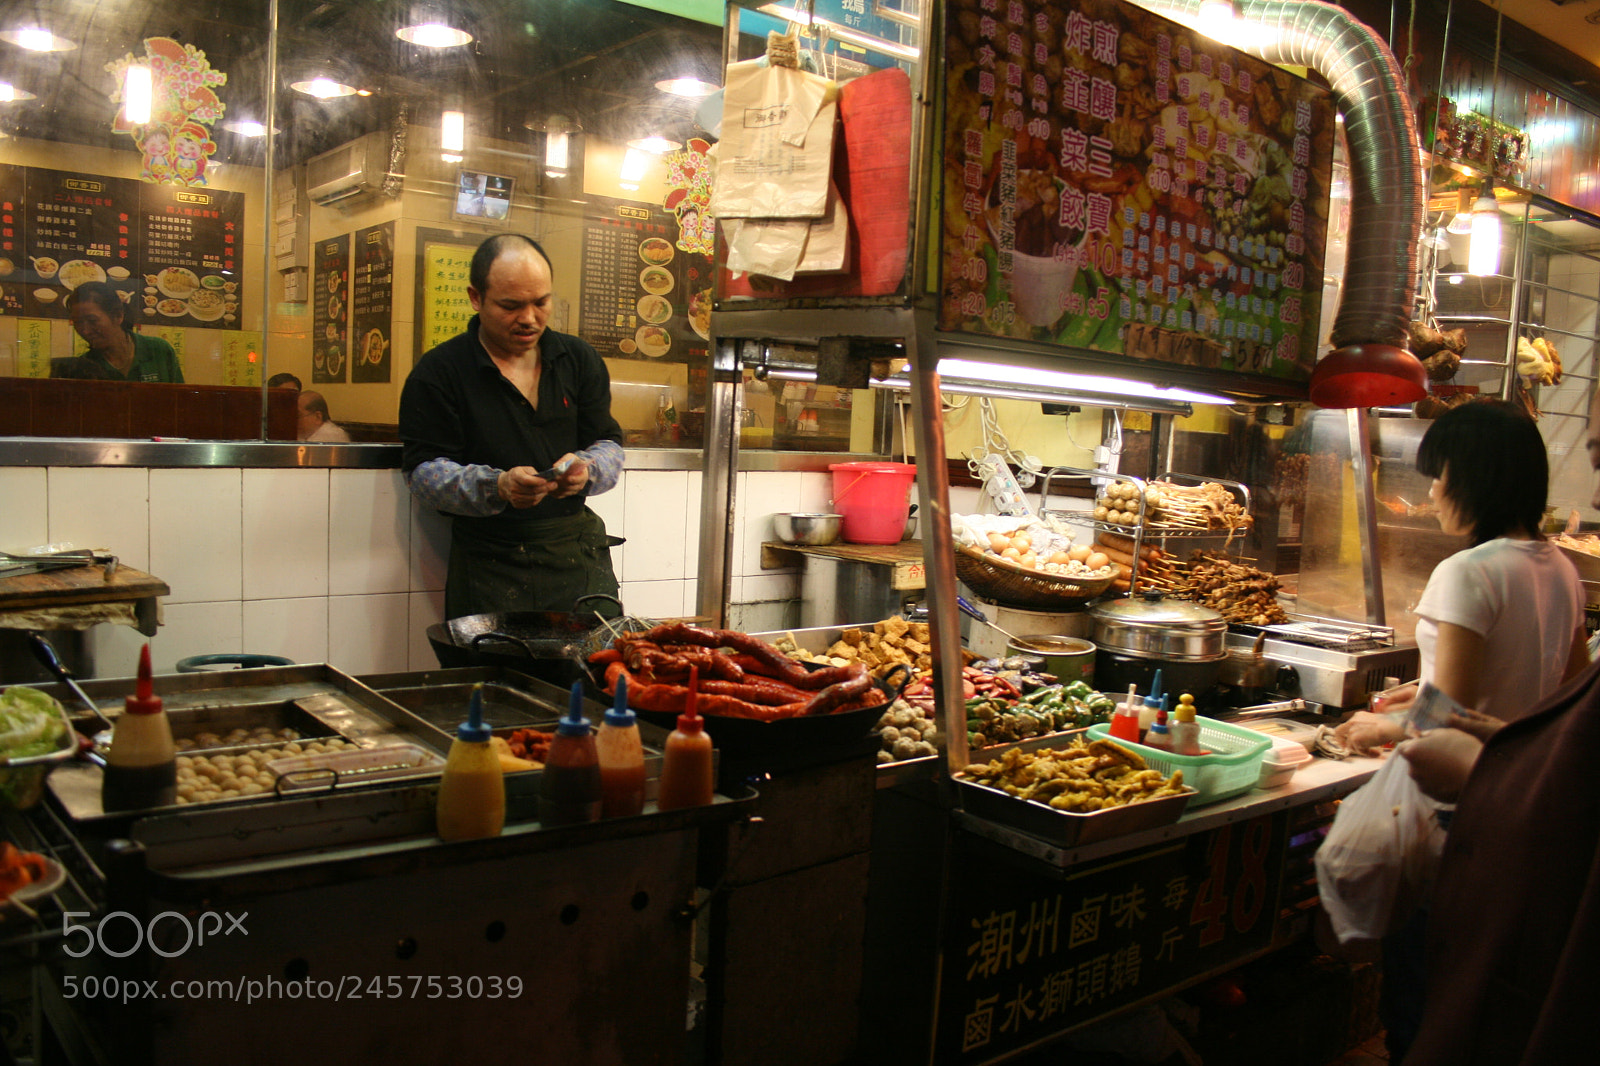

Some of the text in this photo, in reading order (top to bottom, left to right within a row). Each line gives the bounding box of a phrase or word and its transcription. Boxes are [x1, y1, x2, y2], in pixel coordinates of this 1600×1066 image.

[1028, 117, 1051, 140] $10
[1088, 22, 1119, 236] 煎釀三寶
[963, 129, 983, 251] 蘿蔔牛什
[1148, 167, 1171, 193] $10
[962, 256, 987, 283] $10
[1077, 240, 1118, 278] $10
[1282, 260, 1304, 290] $20
[961, 292, 986, 317] $20
[1087, 288, 1111, 321] $5
[1279, 296, 1302, 324] $25
[1276, 334, 1298, 361] $30
[1190, 813, 1272, 948] 48
[966, 883, 1147, 981] 潮州鹵味
[1155, 874, 1190, 962] 每斤
[962, 942, 1142, 1053] 鹵水獅頭鵝
